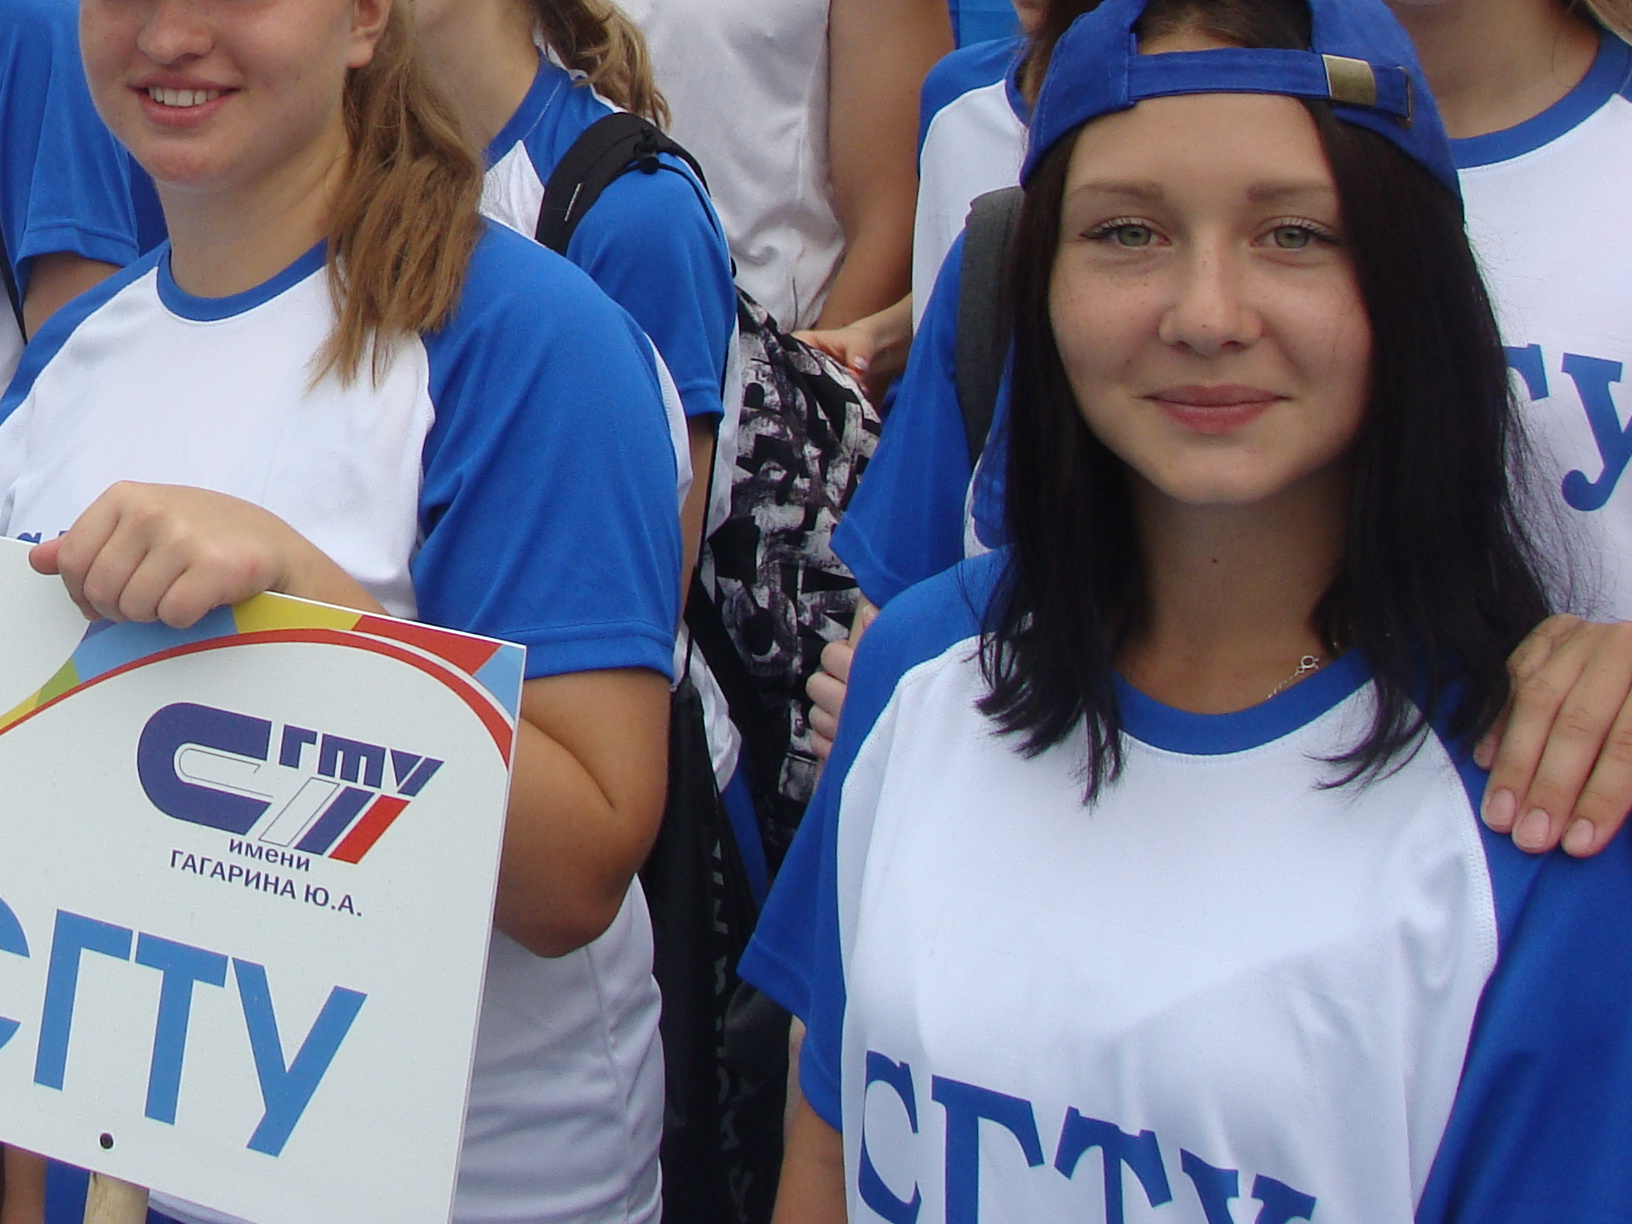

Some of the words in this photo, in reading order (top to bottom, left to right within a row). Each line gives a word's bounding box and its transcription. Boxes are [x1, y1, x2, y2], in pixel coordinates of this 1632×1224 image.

[227, 836, 312, 873] имени
[169, 848, 297, 901] ГАГАРИНА
[304, 882, 363, 918] Ю.А.
